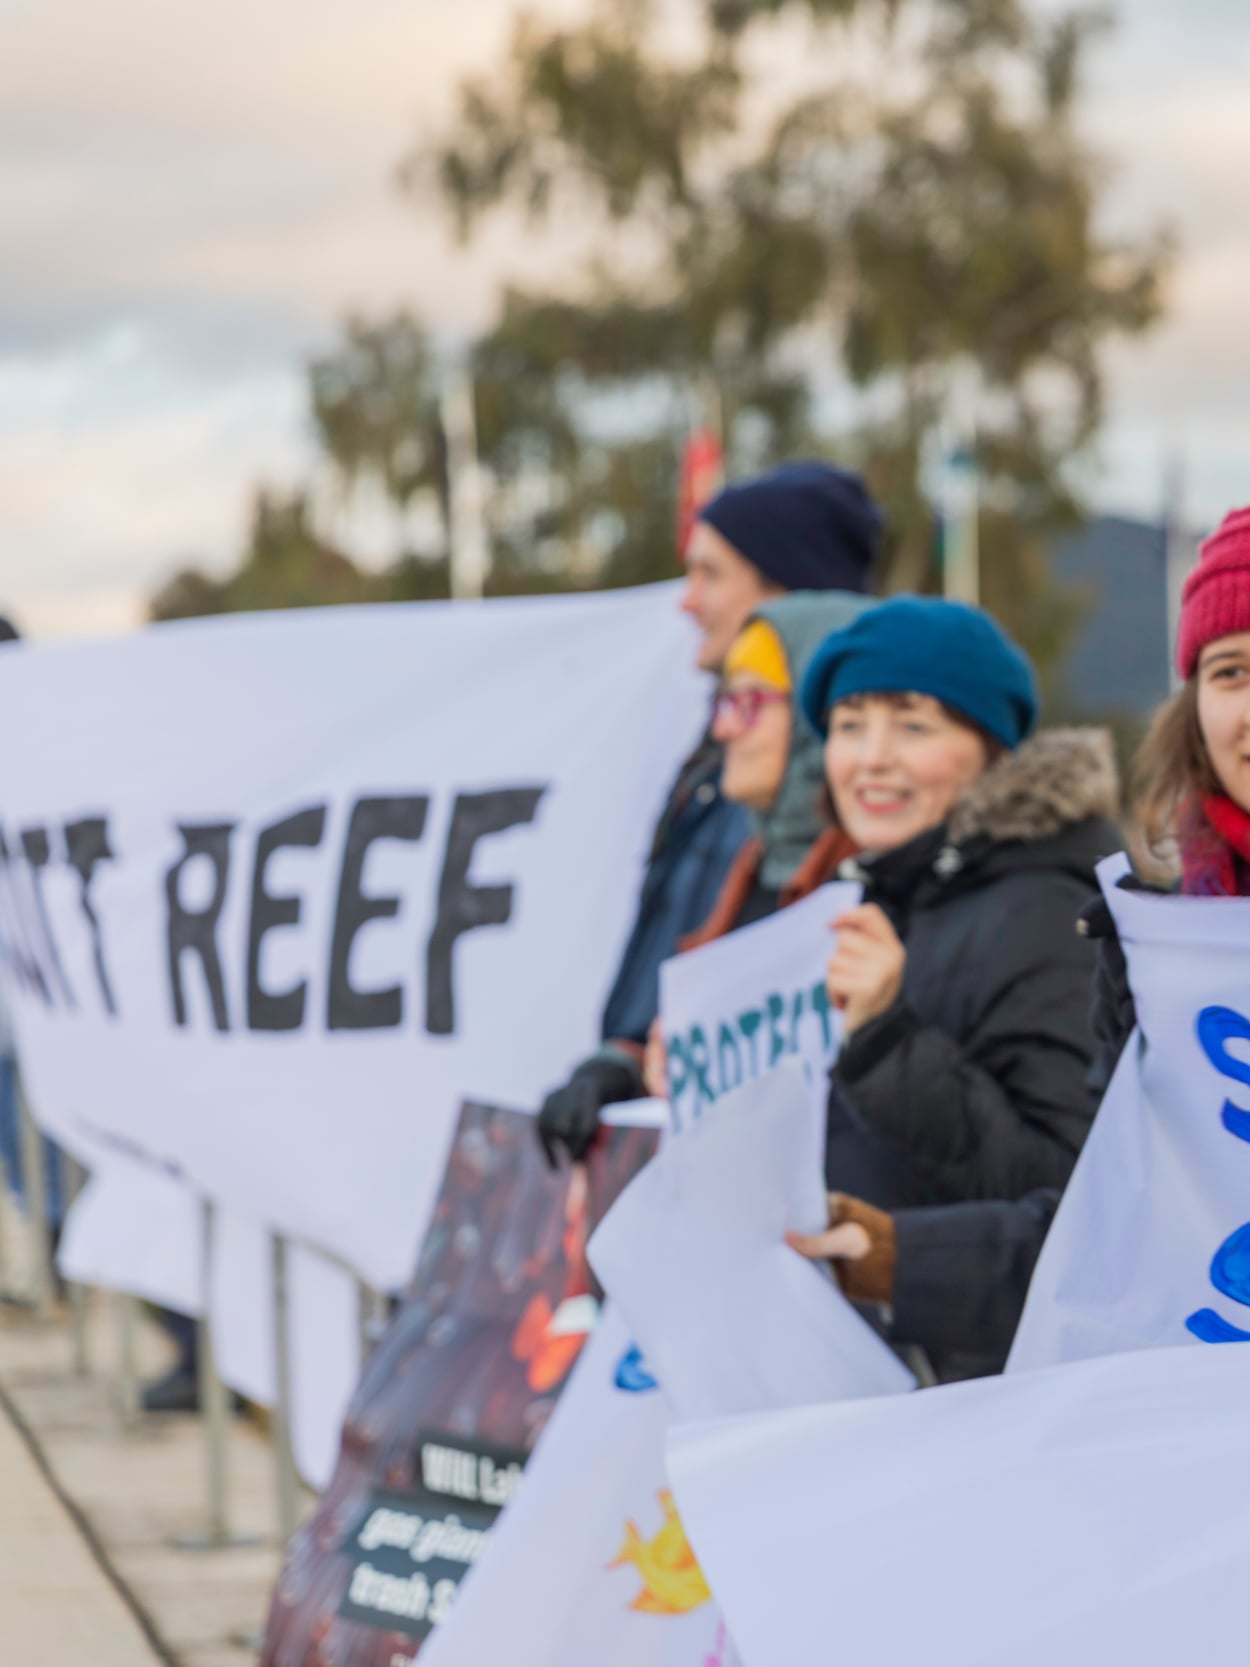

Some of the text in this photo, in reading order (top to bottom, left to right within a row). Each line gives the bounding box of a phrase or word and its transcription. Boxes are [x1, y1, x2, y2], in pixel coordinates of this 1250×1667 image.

[166, 785, 549, 1033] REEF
[422, 1442, 478, 1500] Will
[358, 1507, 489, 1563] gas gian
[350, 1562, 460, 1624] trash S
